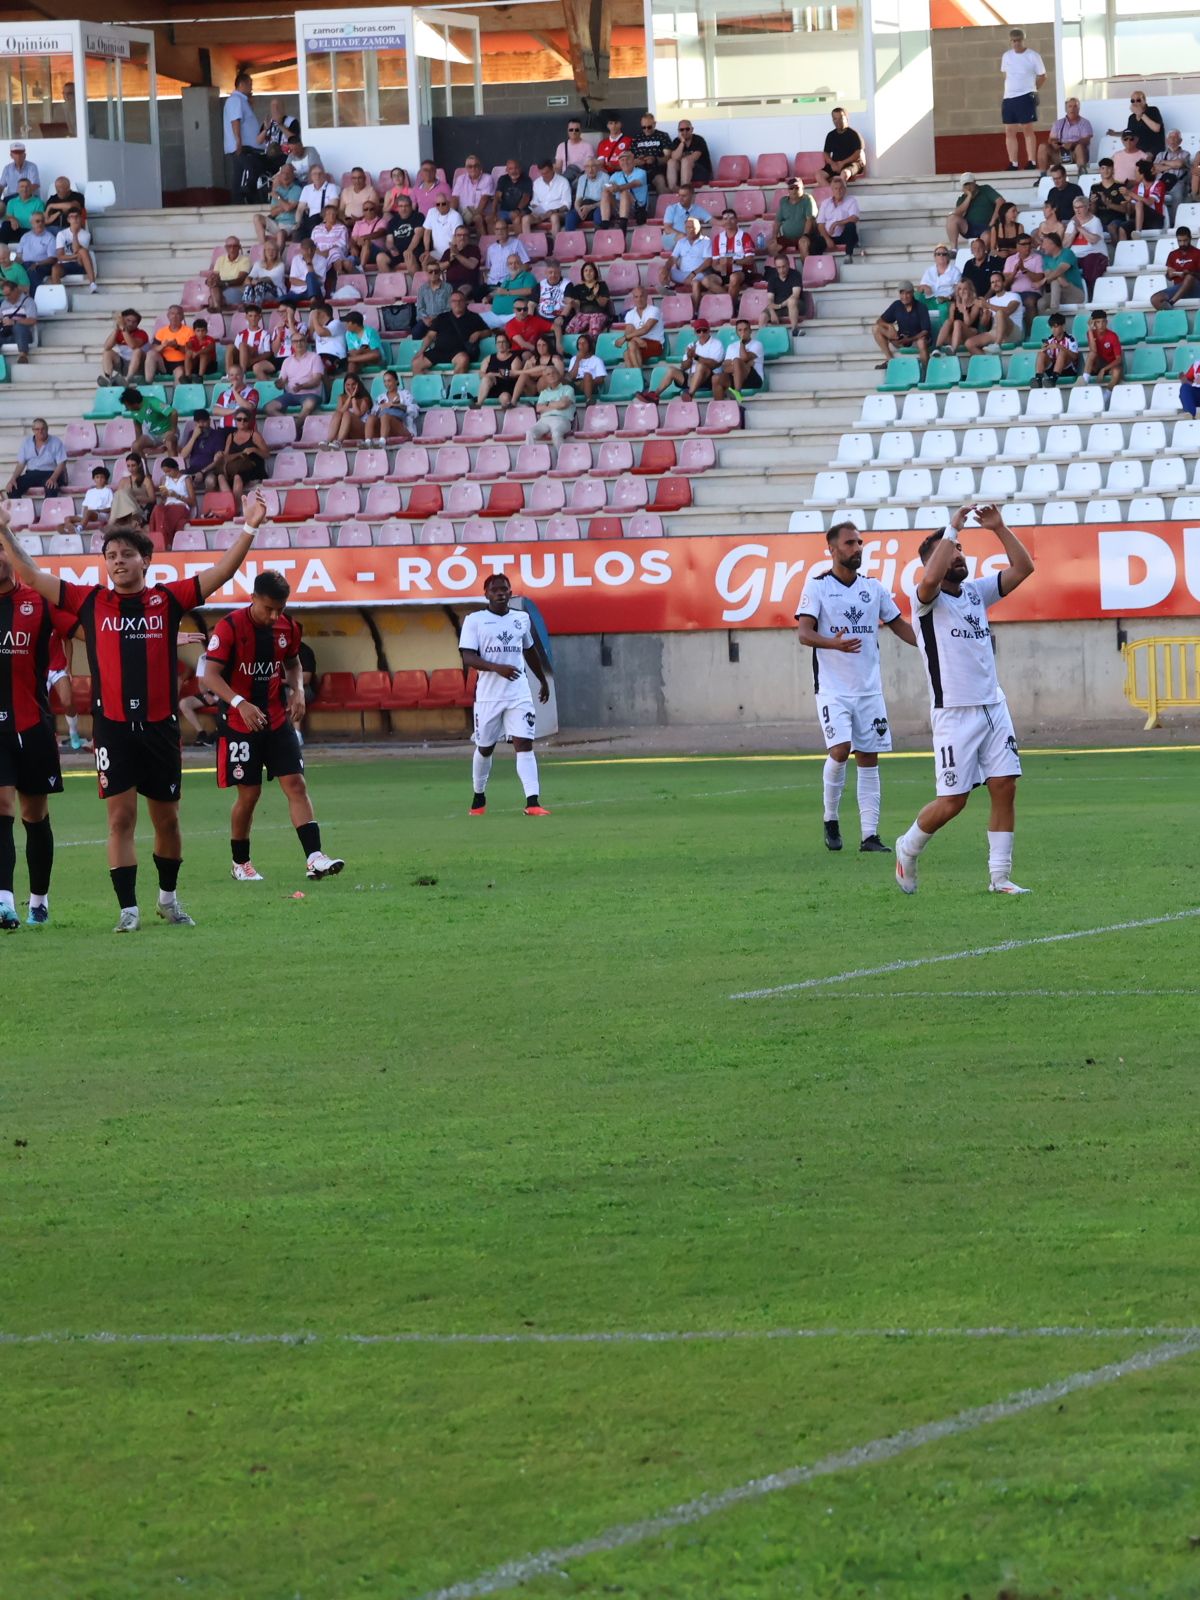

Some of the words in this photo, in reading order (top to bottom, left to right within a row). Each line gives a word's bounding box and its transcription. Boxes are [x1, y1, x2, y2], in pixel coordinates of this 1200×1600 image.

[6, 37, 59, 54] Opinión
[97, 36, 125, 54] Opinión
[319, 40, 330, 48] EL
[349, 38, 361, 46] DE
[362, 36, 401, 45] ZAMORA
[398, 545, 673, 592] RÓTULOS
[101, 615, 164, 632] AUXADI
[0, 630, 31, 646] ADI
[822, 705, 831, 724] 9
[95, 746, 110, 771] 18
[228, 741, 250, 763] 23
[940, 745, 956, 769] 11
